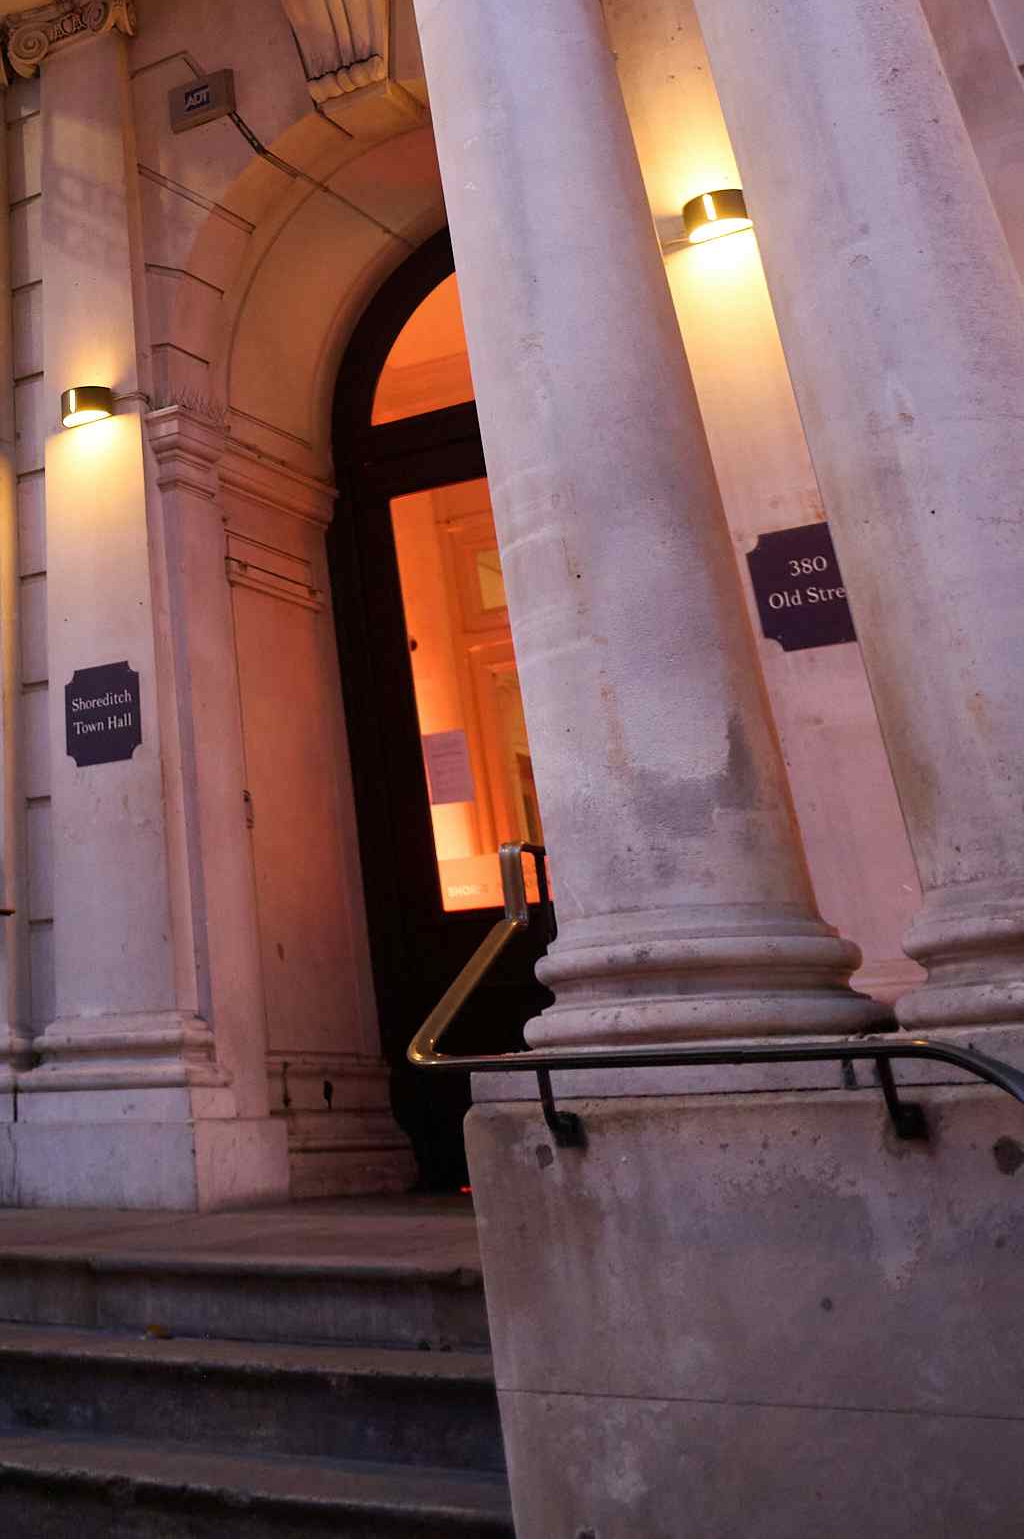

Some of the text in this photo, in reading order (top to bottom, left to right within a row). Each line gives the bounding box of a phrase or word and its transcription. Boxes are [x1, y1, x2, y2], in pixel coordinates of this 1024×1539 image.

[788, 555, 828, 577] 380
[768, 586, 848, 610] Old Stre
[71, 688, 132, 713] Shoreditch
[72, 712, 132, 736] Town Hall
